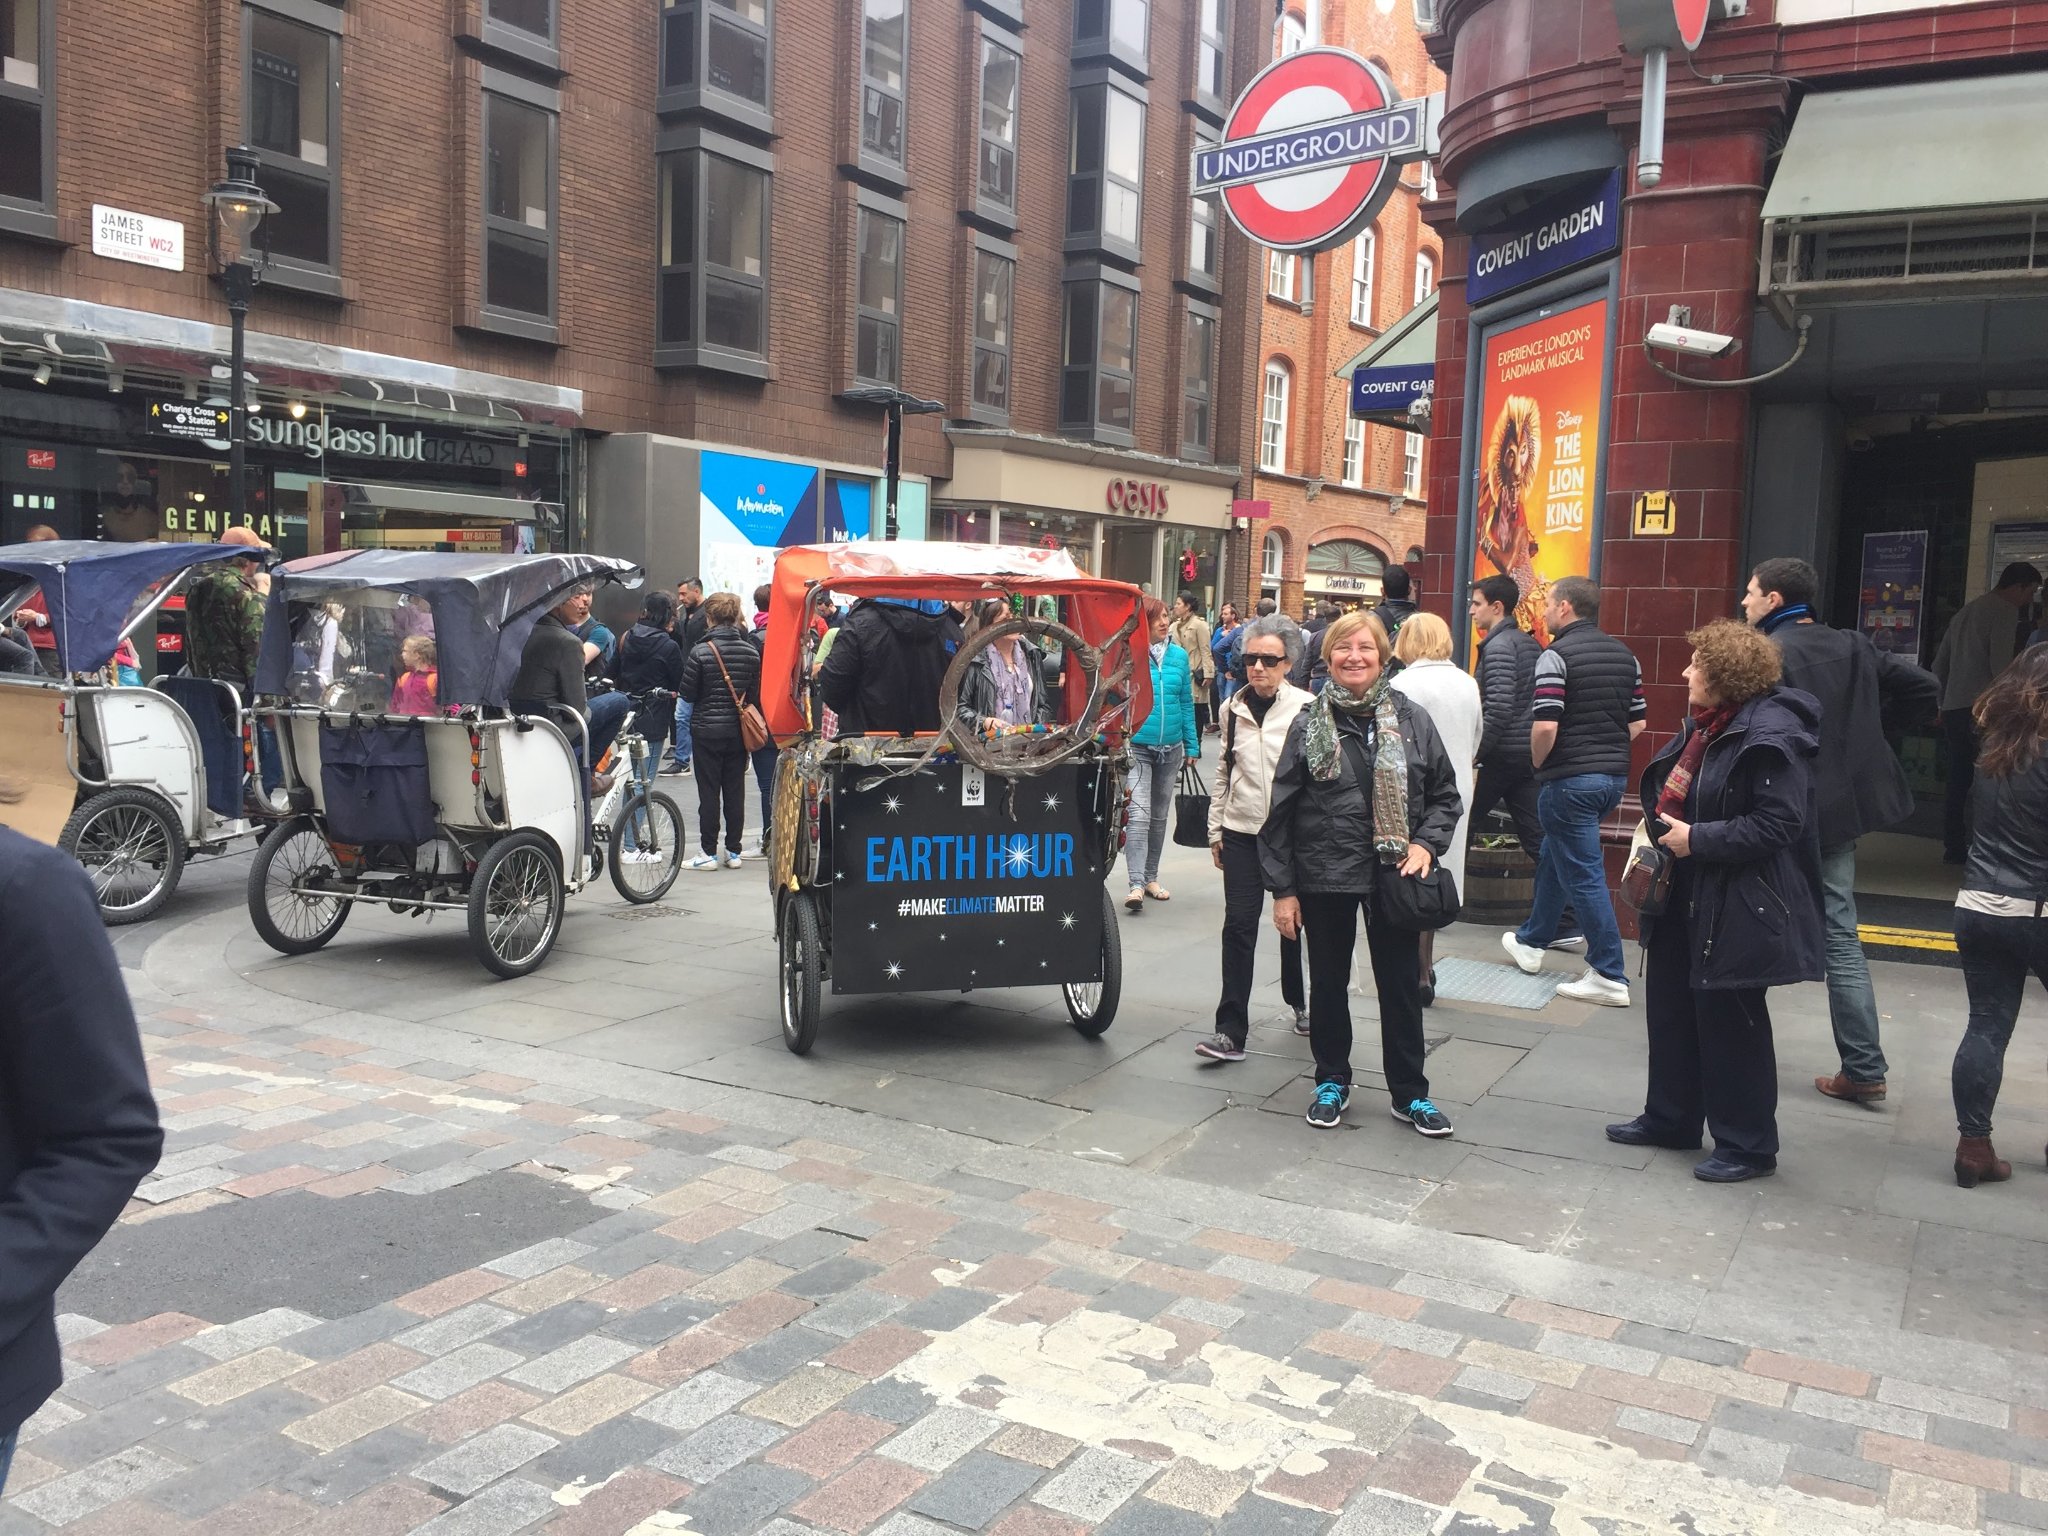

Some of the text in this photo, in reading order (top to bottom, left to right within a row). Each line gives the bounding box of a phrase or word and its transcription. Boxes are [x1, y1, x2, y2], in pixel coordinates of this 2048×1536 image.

[1202, 115, 1411, 181] UNDERGROUND
[101, 212, 144, 231] JAMES
[101, 227, 174, 253] STREET WC2
[1476, 201, 1604, 277] COVENT GARDEN
[1498, 325, 1591, 367] EXPERIENCE LONDON'S
[1501, 345, 1585, 383] LANDMARK MUSICAL
[1361, 381, 1408, 394] COVENT
[162, 403, 216, 417] Charing Cross
[187, 415, 216, 426] Station
[247, 414, 426, 461] sunglass hut
[1554, 431, 1581, 459] THE
[1548, 465, 1585, 494] LION
[1545, 500, 1583, 527] KING
[463, 531, 486, 541] RAY-BAN
[866, 832, 1074, 883] EARTH HOUR
[898, 894, 1045, 917] #MAKECLIMATEMATTER
